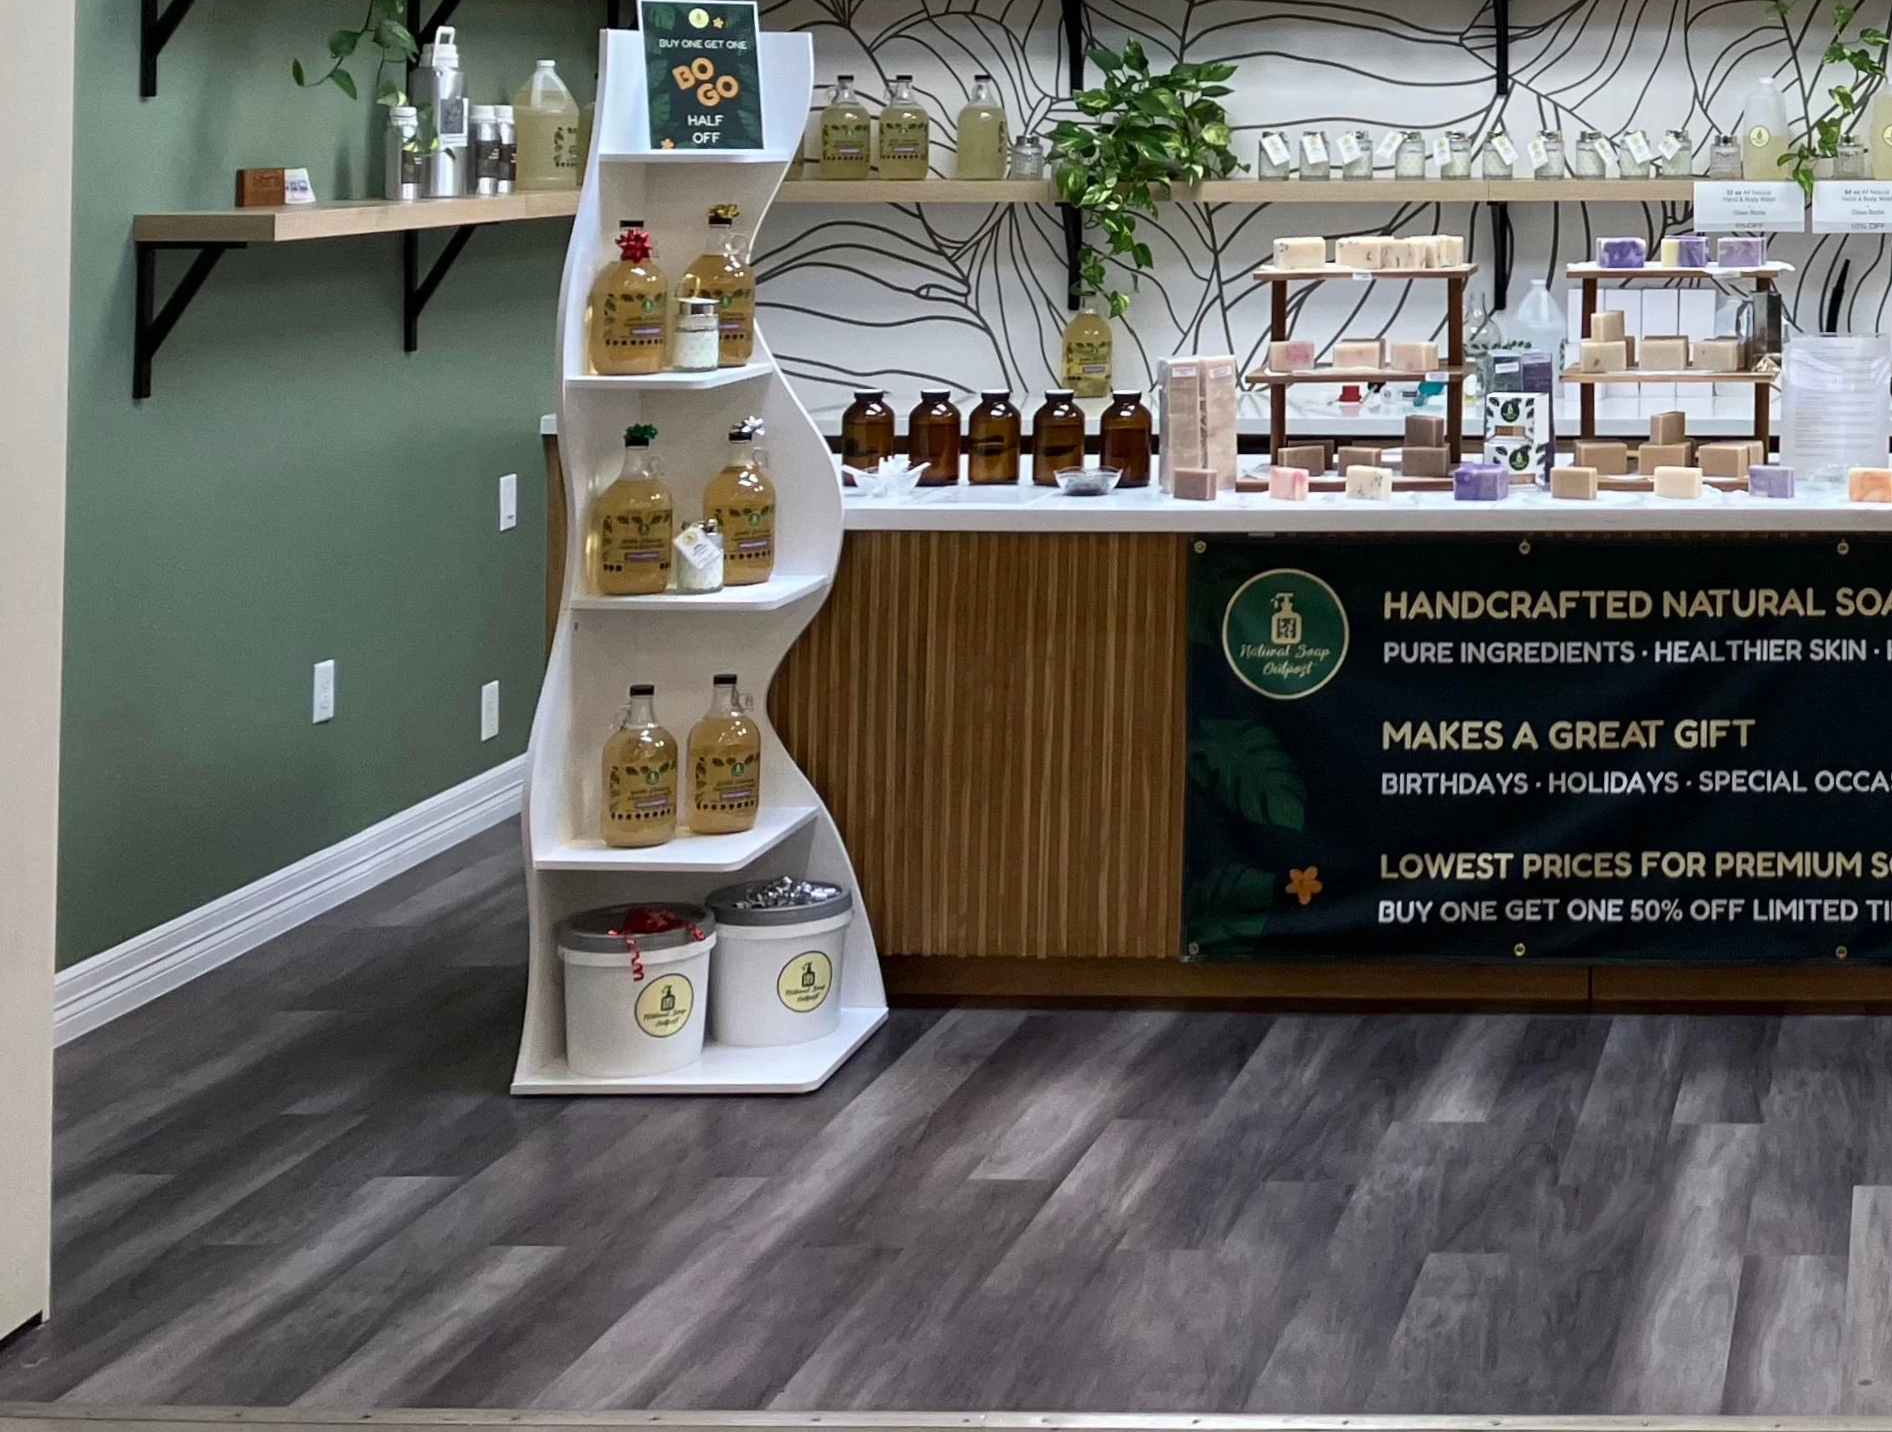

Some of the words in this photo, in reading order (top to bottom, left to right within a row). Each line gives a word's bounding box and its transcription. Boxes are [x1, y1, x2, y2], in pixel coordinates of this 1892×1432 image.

[658, 38, 680, 48] BUY
[680, 39, 703, 49] ONE
[703, 39, 725, 49] GET
[725, 40, 748, 50] ONE
[687, 114, 724, 127] HALF
[692, 131, 721, 144] OFF
[1383, 590, 1653, 620] HANDCRAFTED
[1662, 587, 1827, 619] NATURAL
[1240, 643, 1291, 659] Natural
[1295, 643, 1331, 662] Soap
[1383, 641, 1454, 664] PURE
[1460, 640, 1636, 664] INGREDIENTS
[1654, 638, 1803, 663] HEALTHIER
[1809, 638, 1867, 662] SKIN
[1262, 660, 1317, 679] Outpost
[1382, 720, 1504, 751] MAKES
[1511, 721, 1539, 750] A
[1548, 719, 1665, 750] GREAT
[1674, 718, 1756, 749] GIFT
[1381, 772, 1529, 795] BIRTHDAYS
[1548, 771, 1679, 795] HOLIDAYS
[1699, 769, 1808, 793] SPECIAL
[1380, 852, 1515, 880] LOWEST
[1522, 851, 1633, 880] PRICES
[1641, 851, 1706, 878] FOR
[1715, 851, 1862, 878] PREMIUM
[1378, 900, 1434, 923] BUY
[1439, 900, 1498, 922] ONE
[1504, 898, 1561, 921] GET
[1566, 898, 1624, 922] ONE
[1630, 898, 1683, 922] 50%
[1689, 898, 1746, 921] OFF
[1753, 898, 1859, 922] LIMITED
